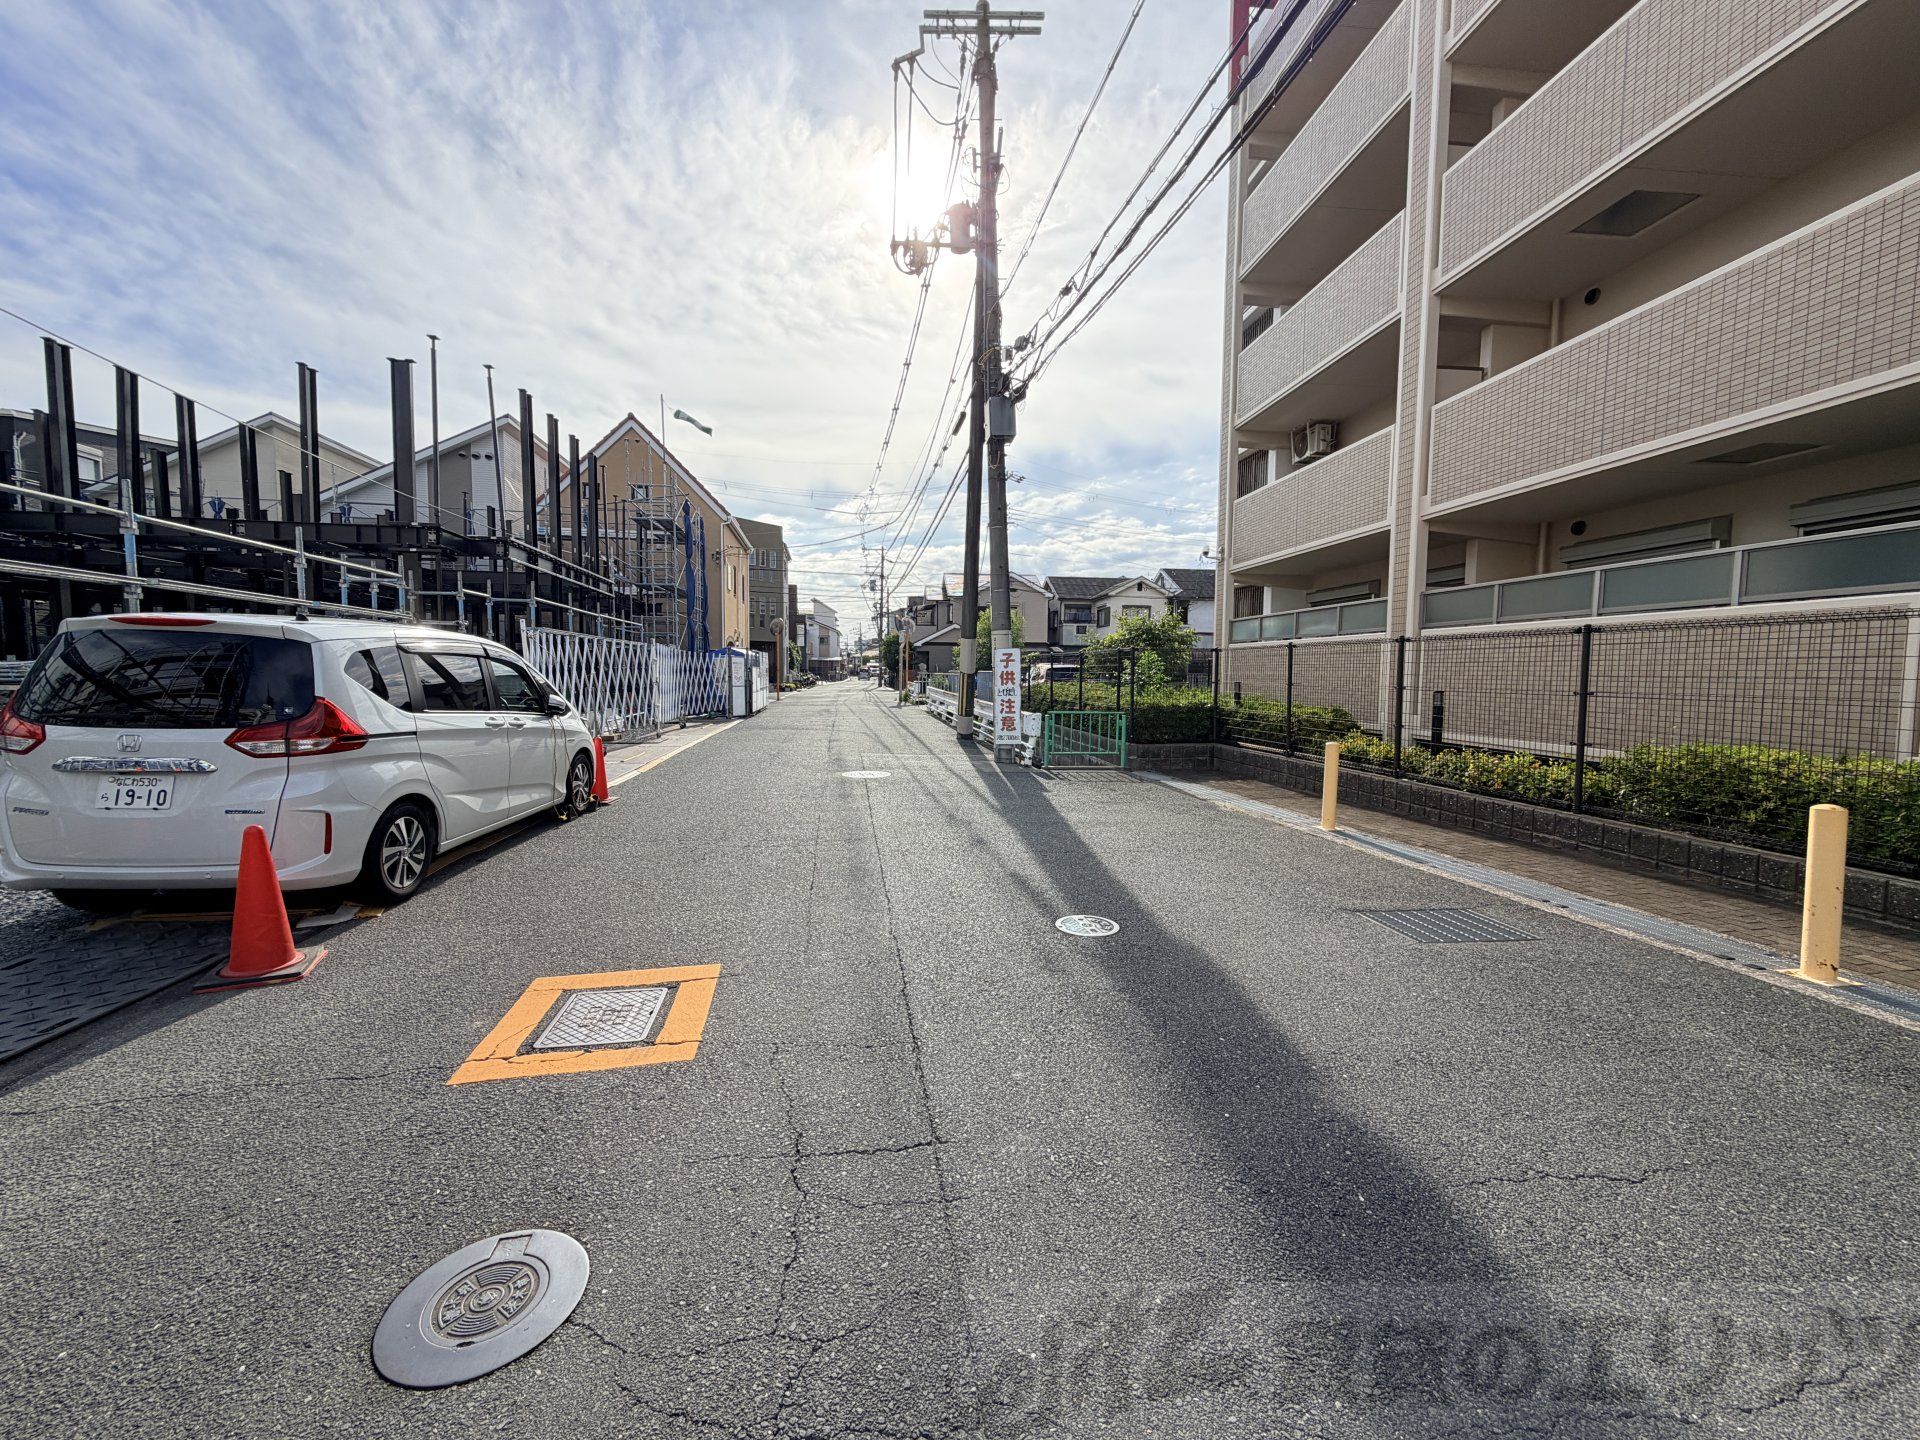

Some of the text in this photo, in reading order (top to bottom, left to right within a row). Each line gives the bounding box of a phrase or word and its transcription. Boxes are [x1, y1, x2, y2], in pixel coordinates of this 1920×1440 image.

[1000, 652, 1016, 685] 子供
[1000, 698, 1017, 732] 注意
[114, 789, 168, 806] 19-10
